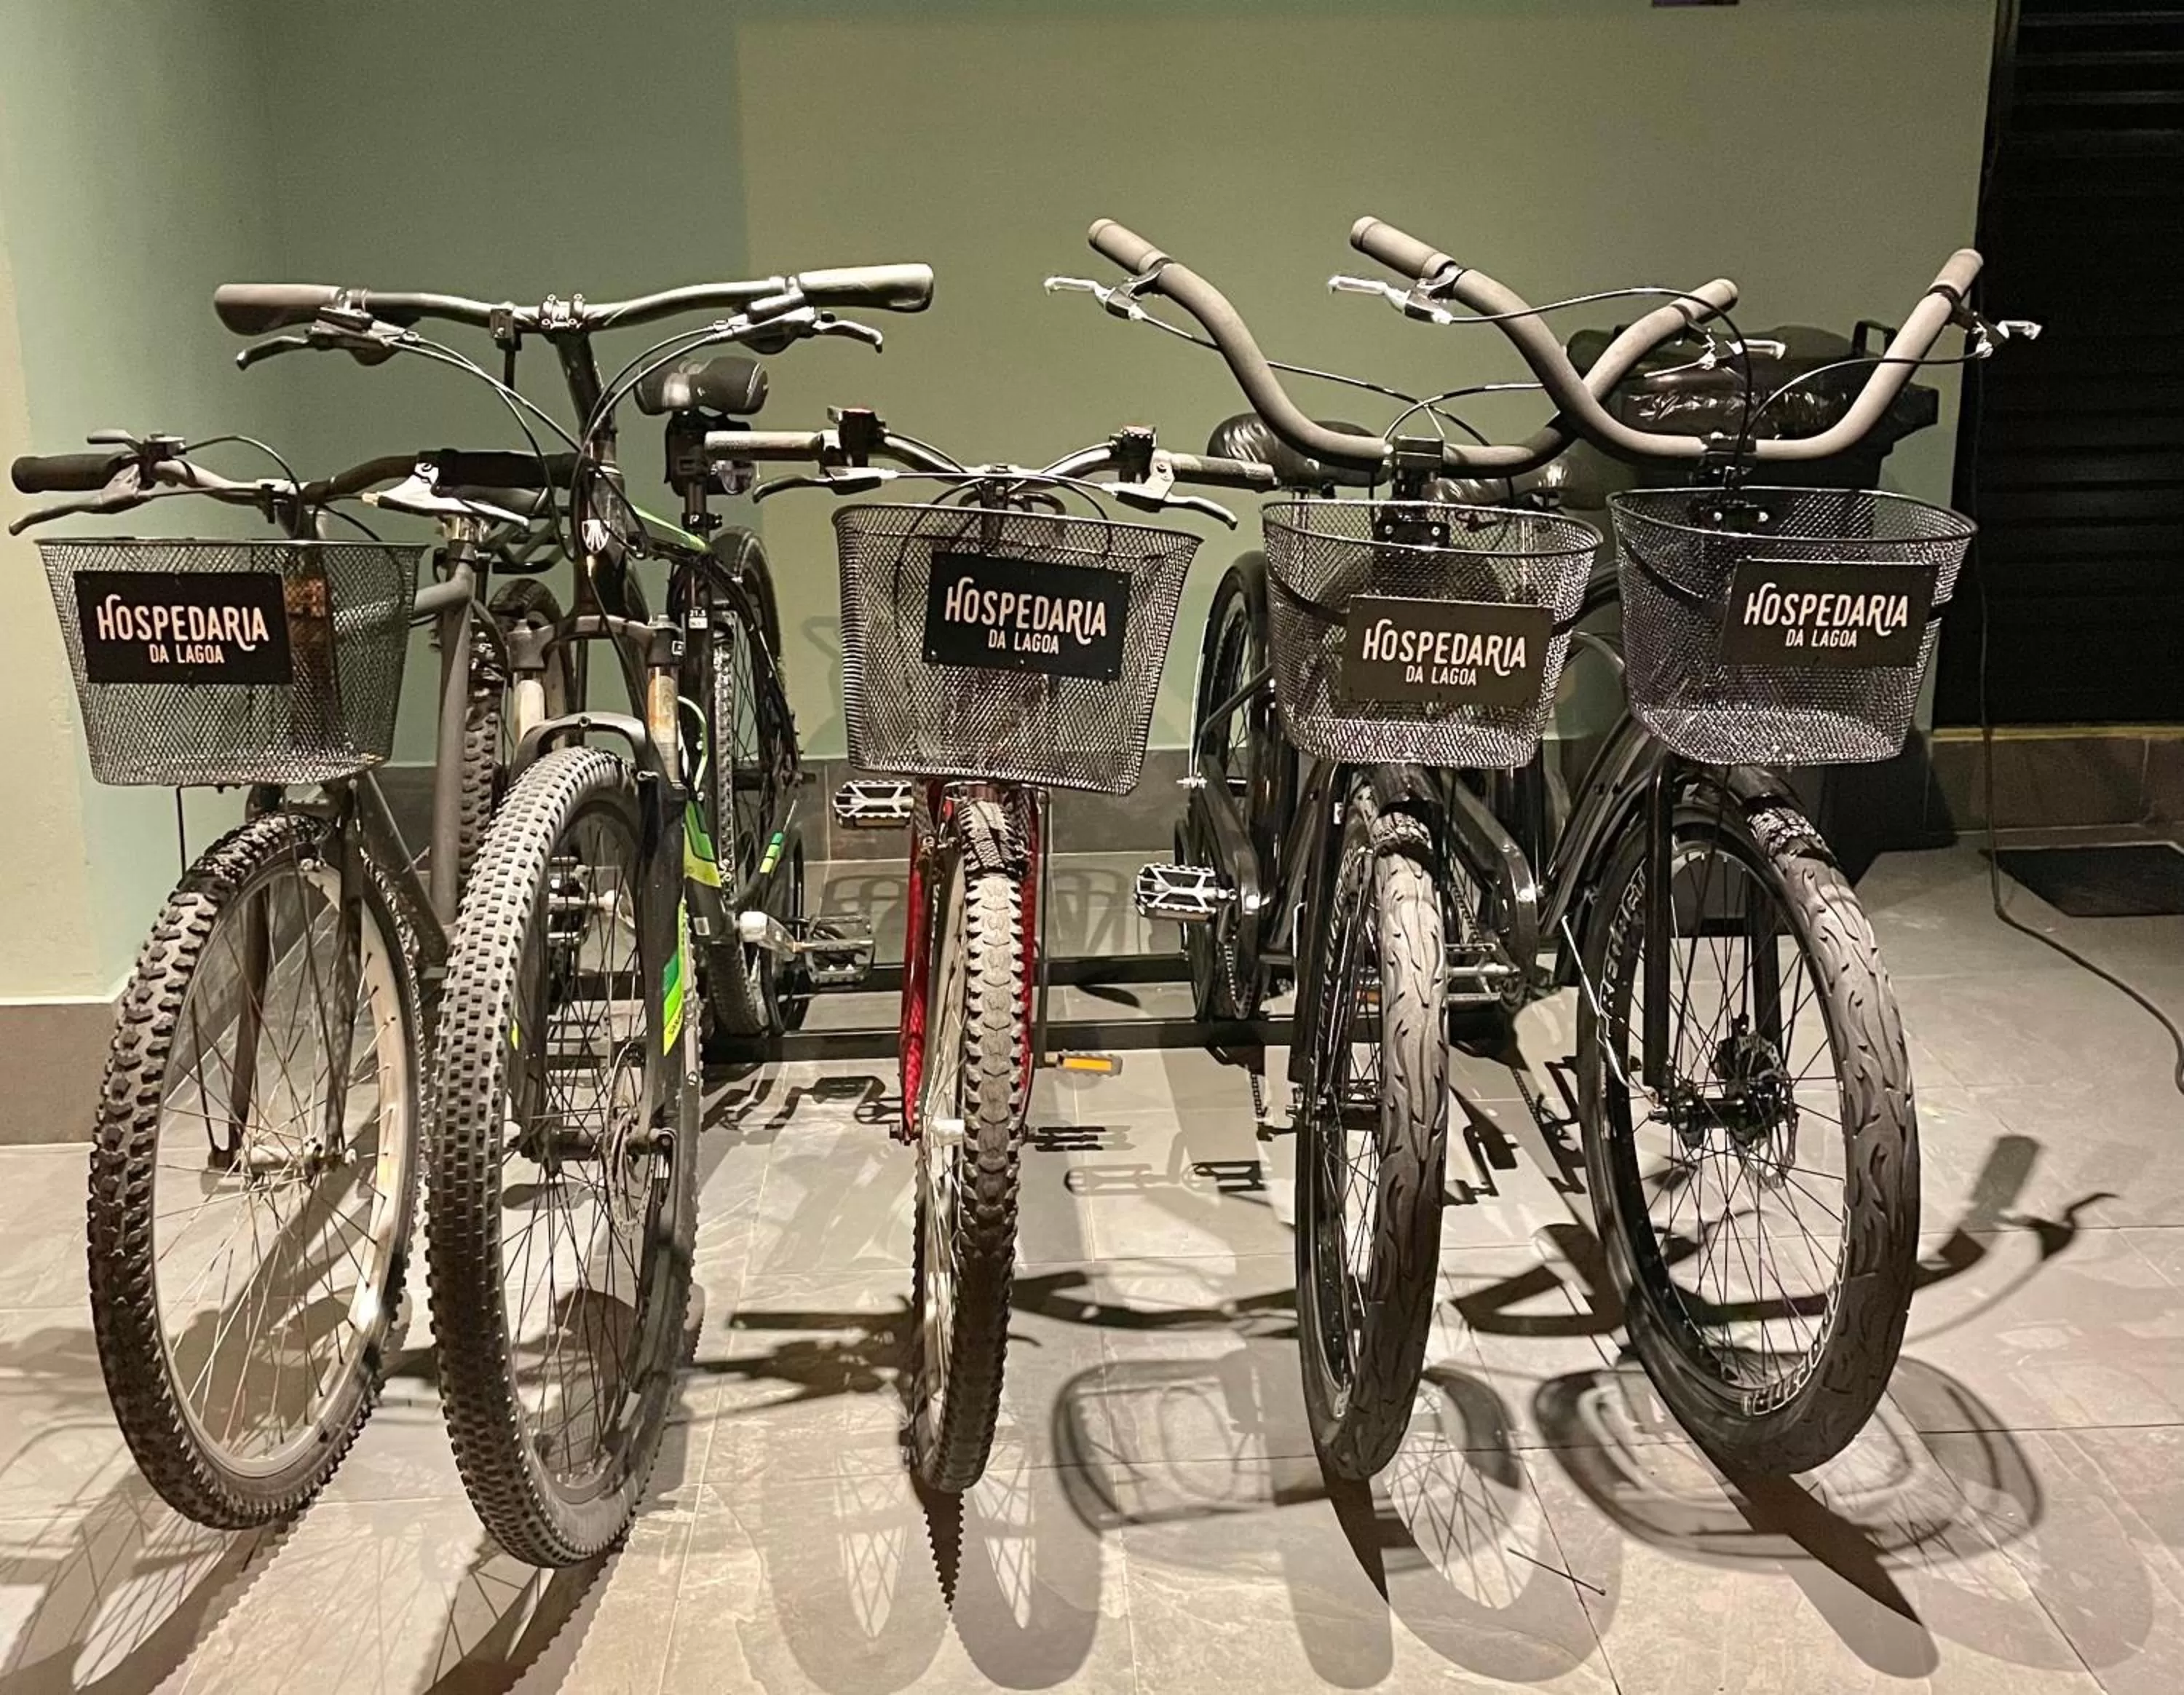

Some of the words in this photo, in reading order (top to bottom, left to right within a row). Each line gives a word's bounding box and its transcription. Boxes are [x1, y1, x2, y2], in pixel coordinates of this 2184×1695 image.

[97, 593, 269, 652] HOSPEDARIA
[944, 577, 1107, 645] HOSPEDARIA
[1744, 582, 1908, 636] HOSPEDARIA
[149, 644, 170, 663] DA
[175, 644, 225, 664] LAGOA
[988, 628, 1006, 649] DA
[1013, 631, 1059, 654] LAGOA
[1362, 618, 1527, 676] HOSPEDARIA
[1785, 628, 1804, 647] DA
[1811, 628, 1857, 647] LAGOA
[1405, 665, 1424, 684] DA
[1431, 665, 1477, 686] LAGOA
